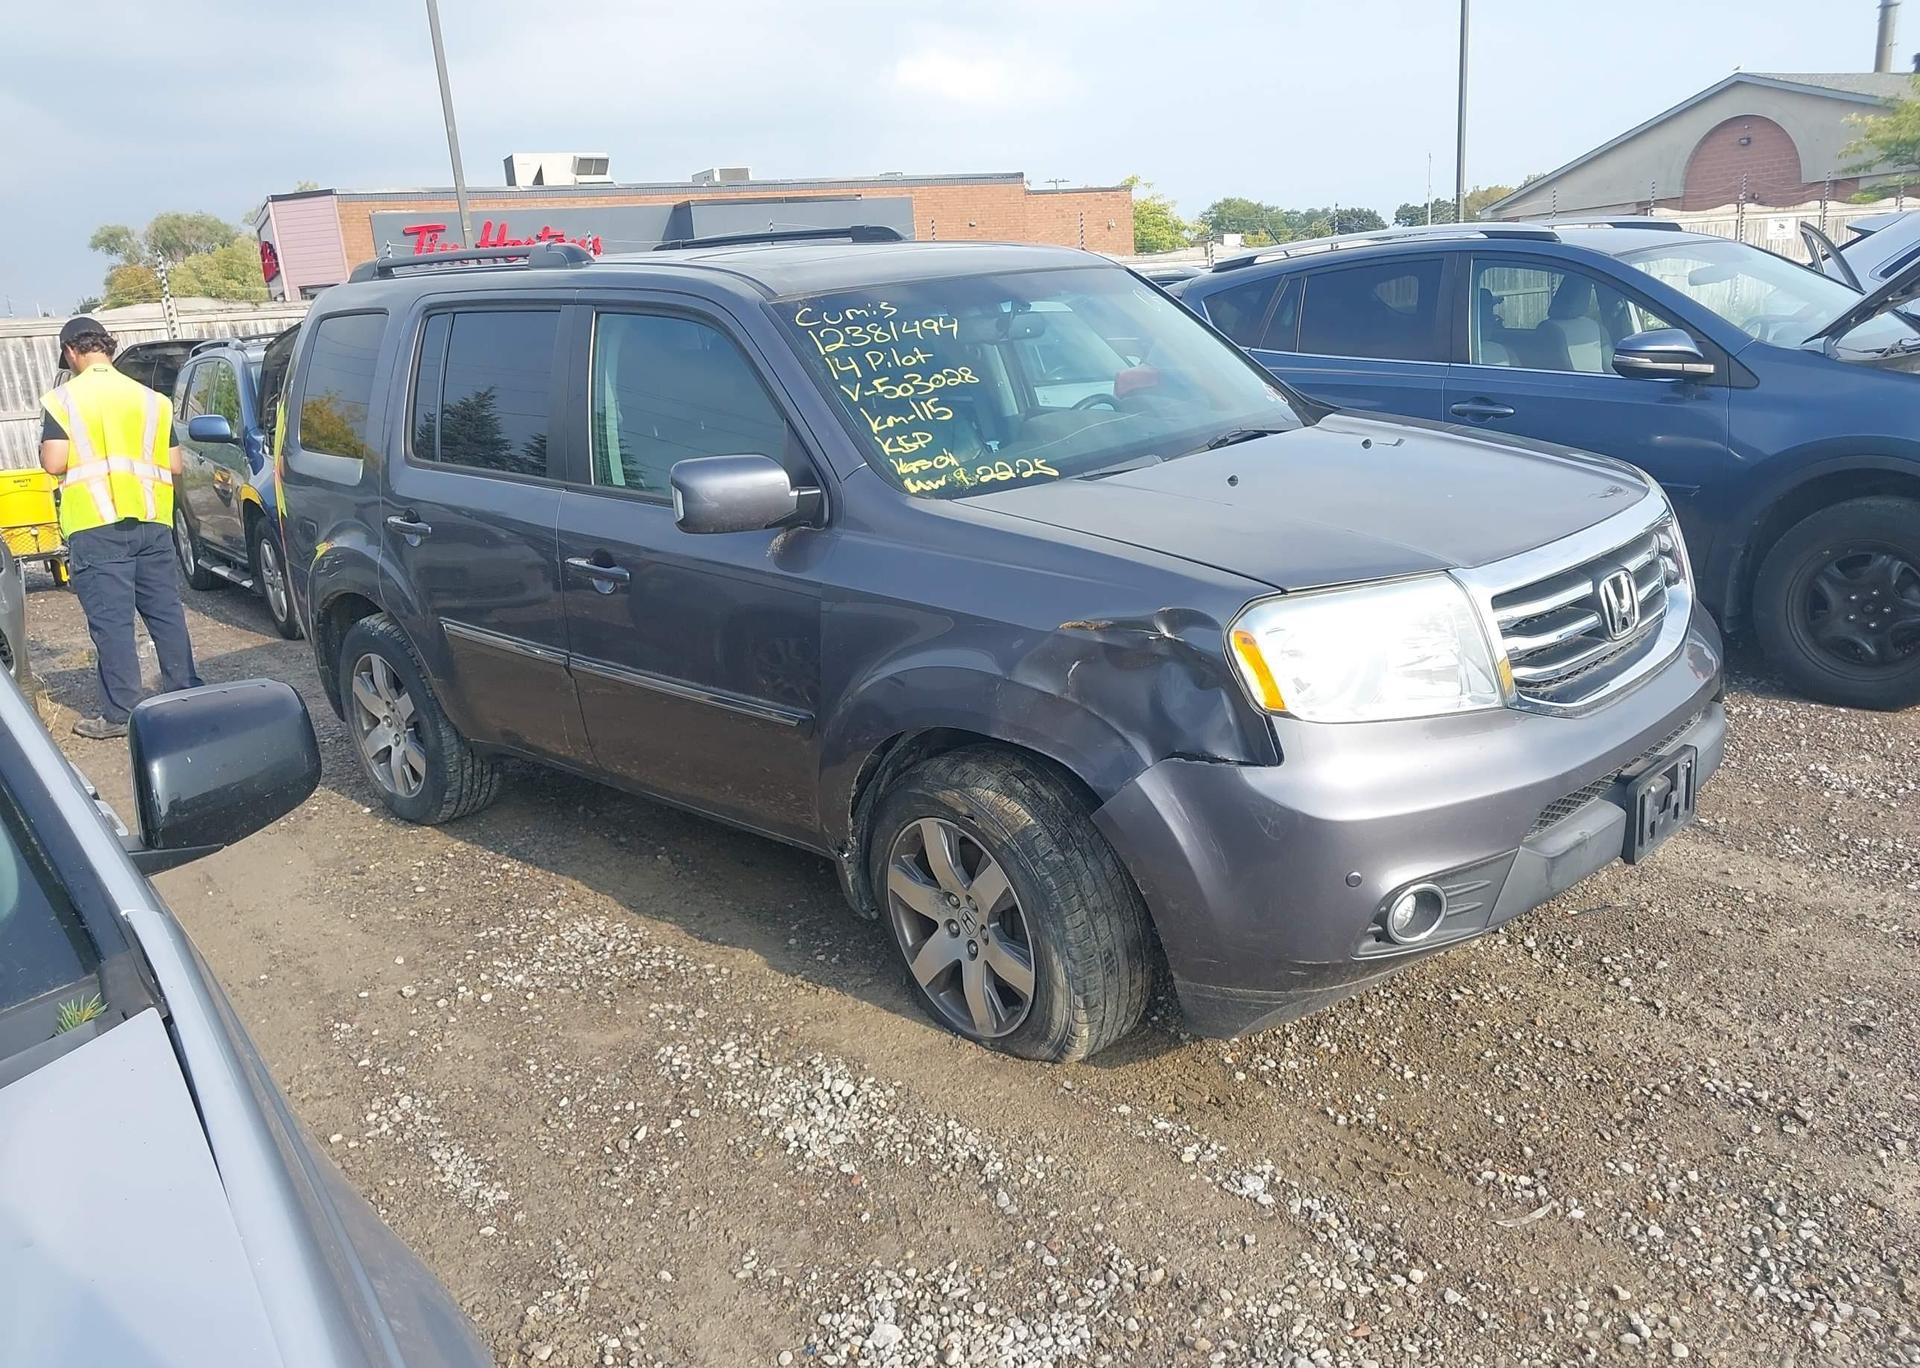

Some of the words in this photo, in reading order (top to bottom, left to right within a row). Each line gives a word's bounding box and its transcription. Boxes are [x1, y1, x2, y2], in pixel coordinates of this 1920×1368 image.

[808, 316, 958, 355] 12381494
[824, 356, 862, 380] 14
[865, 348, 933, 372] Pilot
